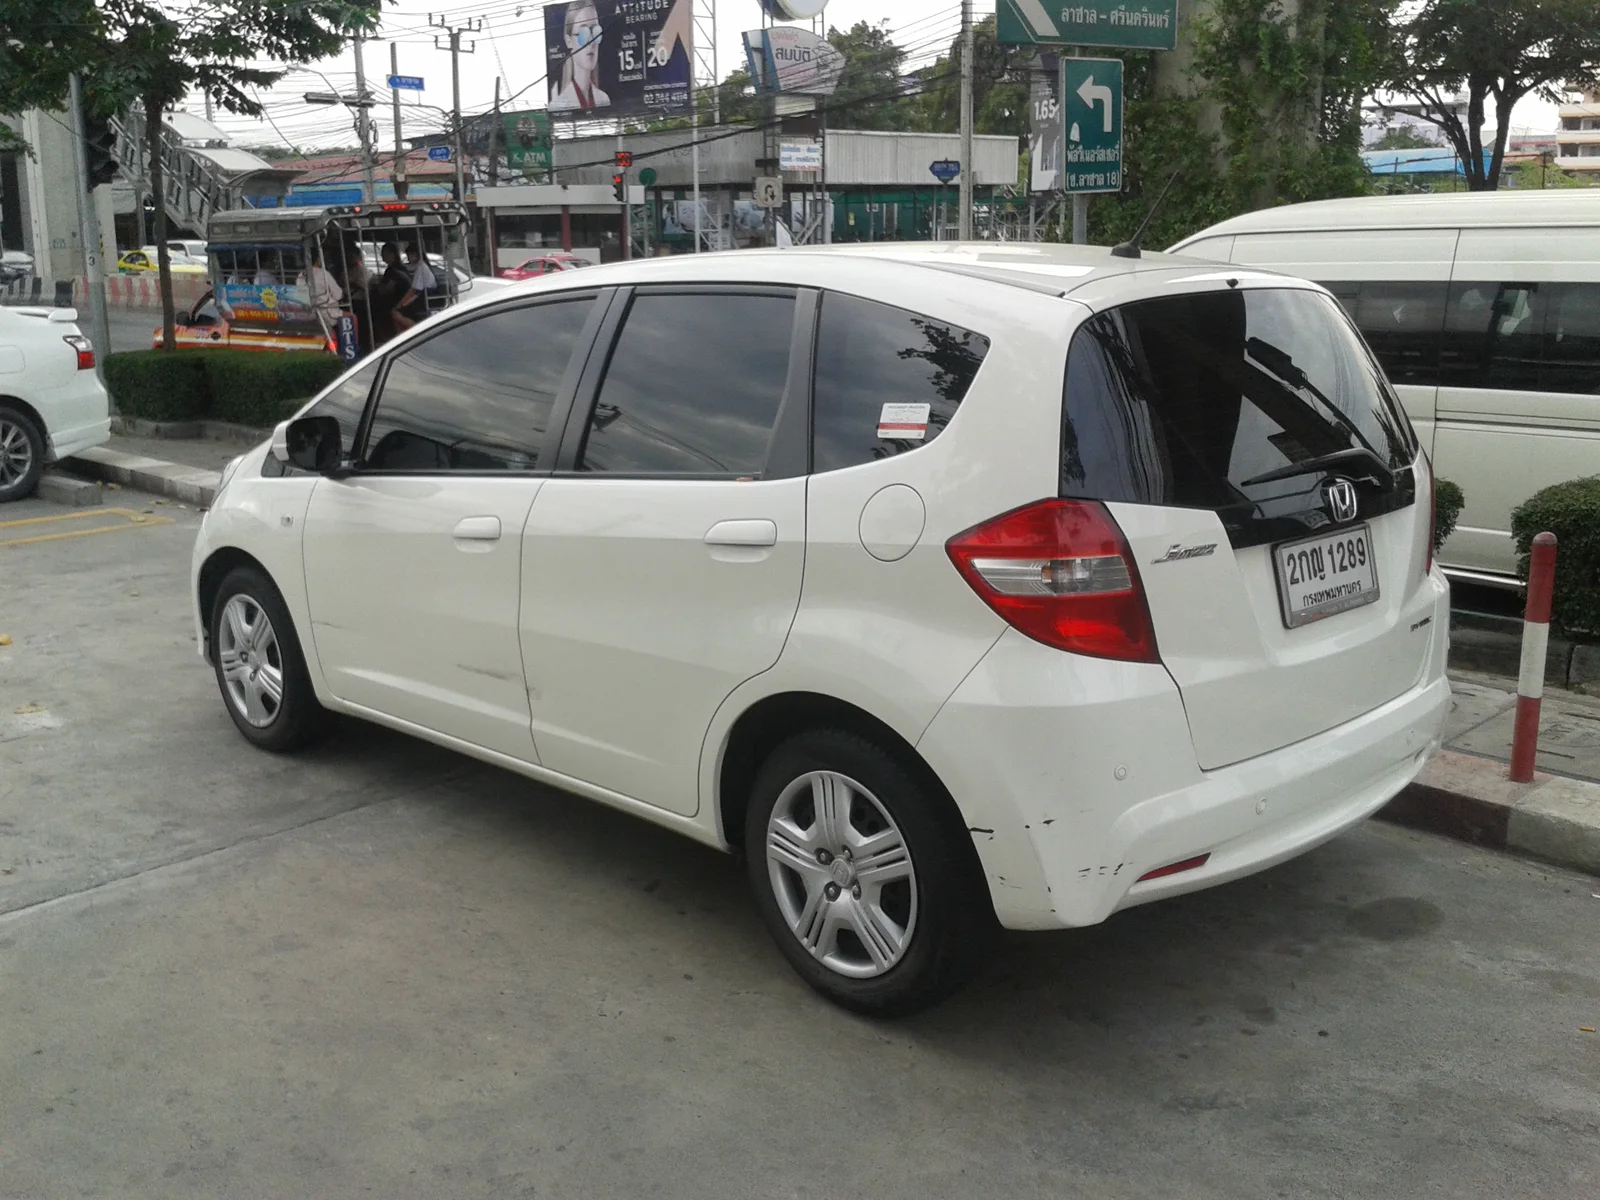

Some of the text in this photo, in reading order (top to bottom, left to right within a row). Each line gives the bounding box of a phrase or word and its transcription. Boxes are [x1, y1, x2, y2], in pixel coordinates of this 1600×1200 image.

[615, 0, 669, 15] ATTITUDE
[1061, 6, 1097, 24] ลาซาล
[625, 12, 658, 24] BEARING
[618, 50, 635, 71] 15
[647, 46, 668, 68] 20
[775, 44, 811, 62] สมบัติ
[523, 151, 546, 163] ATM
[342, 317, 356, 360] BTS
[1287, 537, 1367, 585] 2กญ 1289
